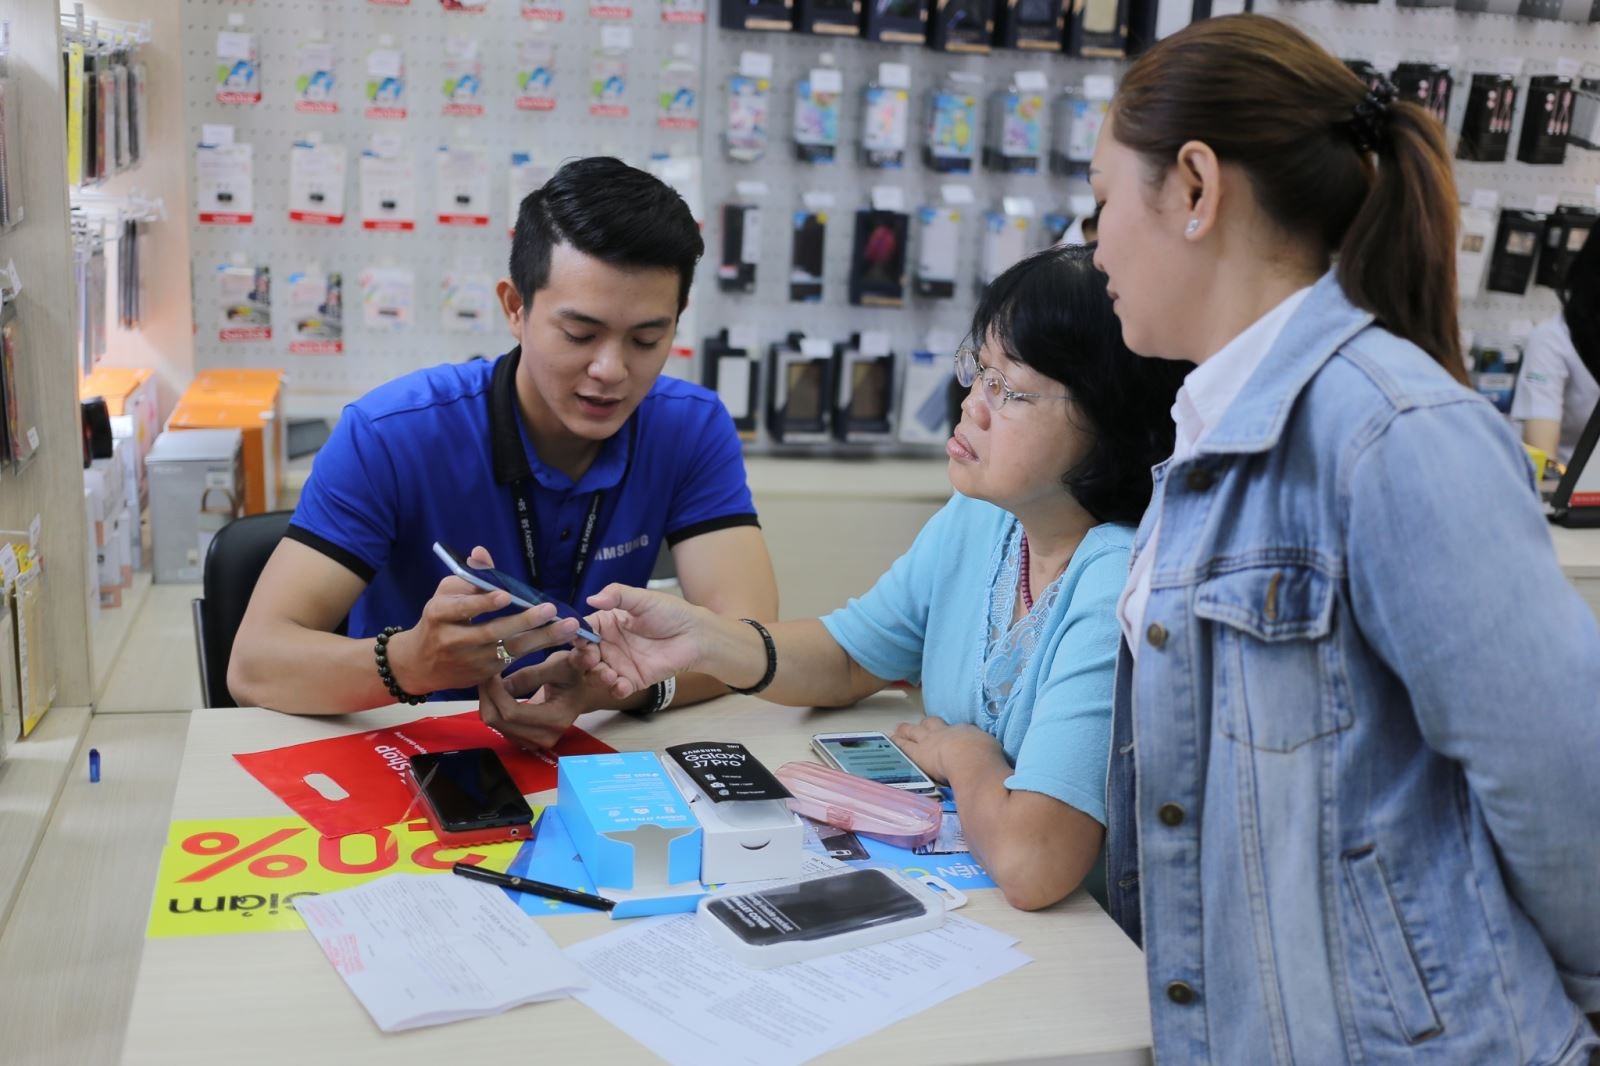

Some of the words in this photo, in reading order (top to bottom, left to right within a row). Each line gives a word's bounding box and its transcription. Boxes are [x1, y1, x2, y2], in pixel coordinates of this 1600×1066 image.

[594, 534, 649, 561] AMSUNG
[682, 748, 722, 756] SAMSUNG
[684, 752, 747, 762] Galaxy
[692, 760, 709, 769] J7
[710, 759, 742, 768] Pro
[175, 827, 488, 883] 20%
